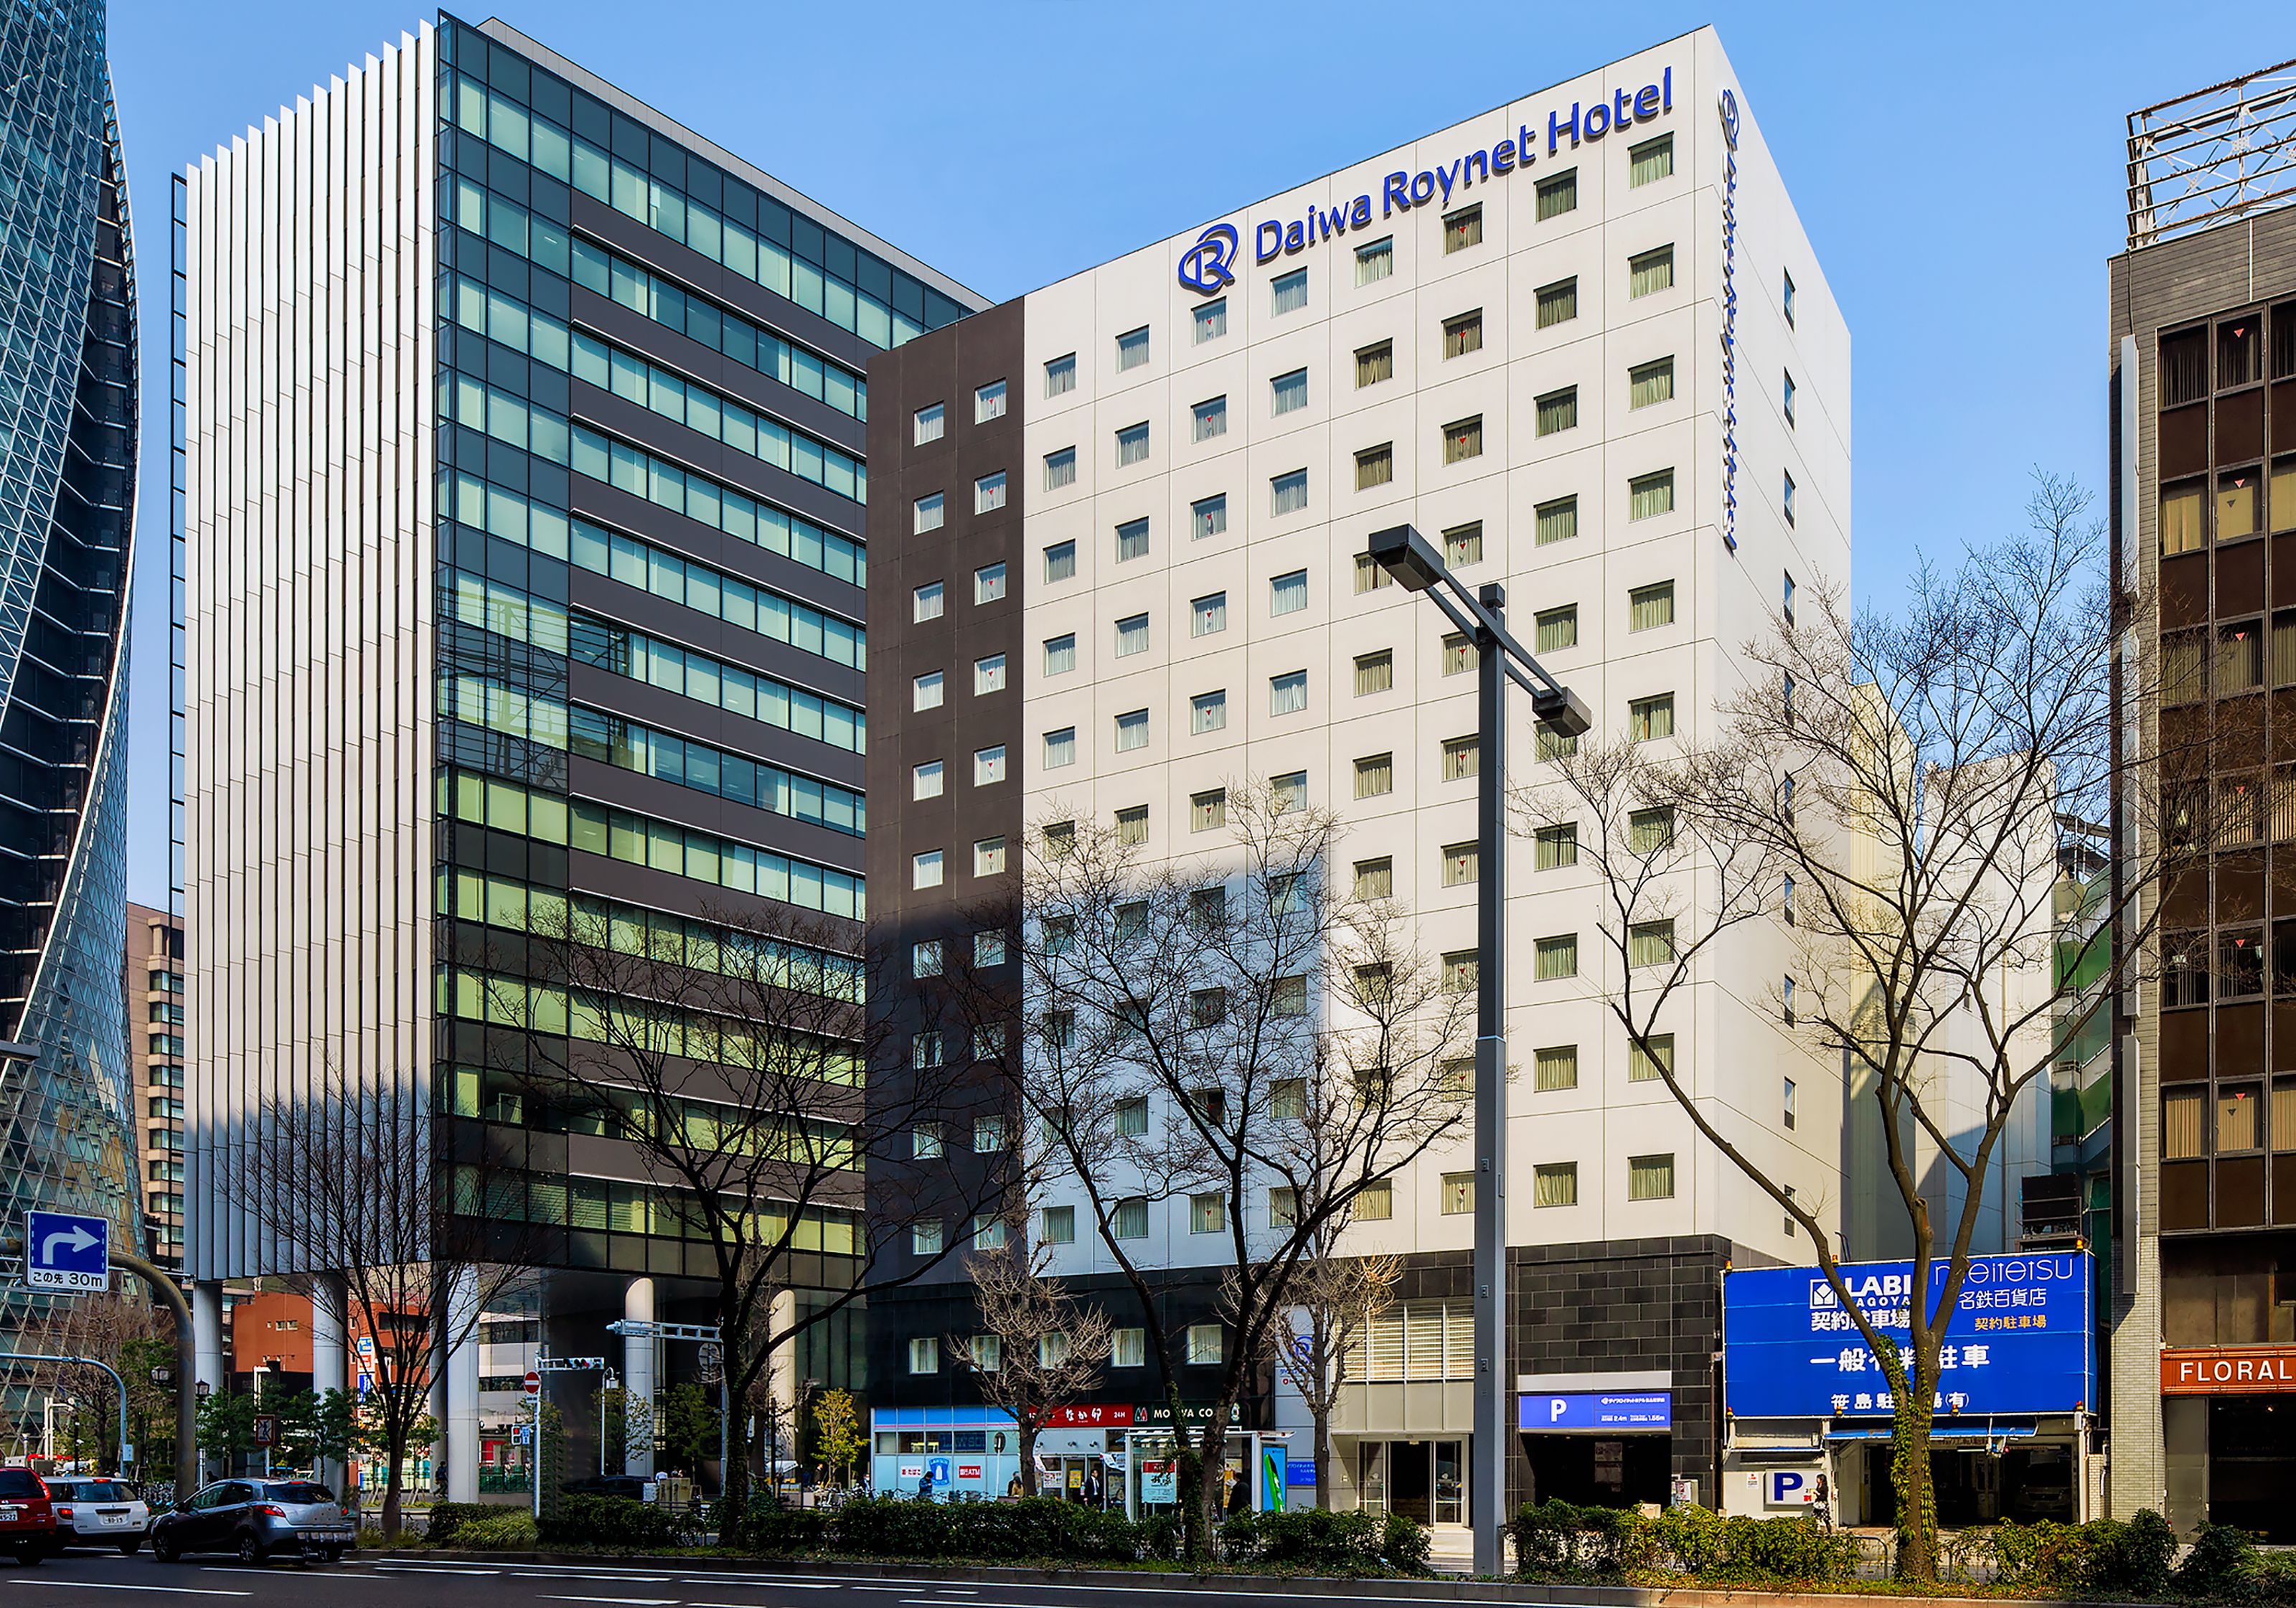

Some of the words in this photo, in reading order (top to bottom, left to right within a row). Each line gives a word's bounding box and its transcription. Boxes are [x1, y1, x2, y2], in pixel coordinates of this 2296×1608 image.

[1256, 191, 1372, 264] Daiwa
[1383, 124, 1535, 217] Roynet
[1549, 66, 1673, 153] Hotel
[33, 1271, 64, 1284] この先
[69, 1273, 102, 1287] 30m
[1845, 1274, 1911, 1297] LABI
[1856, 1296, 1911, 1308] AGOYA
[1959, 1287, 2047, 1310] 名鉄百貨店
[1975, 1315, 2047, 1331] 契約駐車場
[2180, 1360, 2293, 1382] FLORAL
[1065, 1408, 1102, 1422] なか卯
[1154, 1409, 1195, 1419] MOVA
[1551, 1398, 1567, 1422] P
[1774, 1472, 1803, 1501] P
